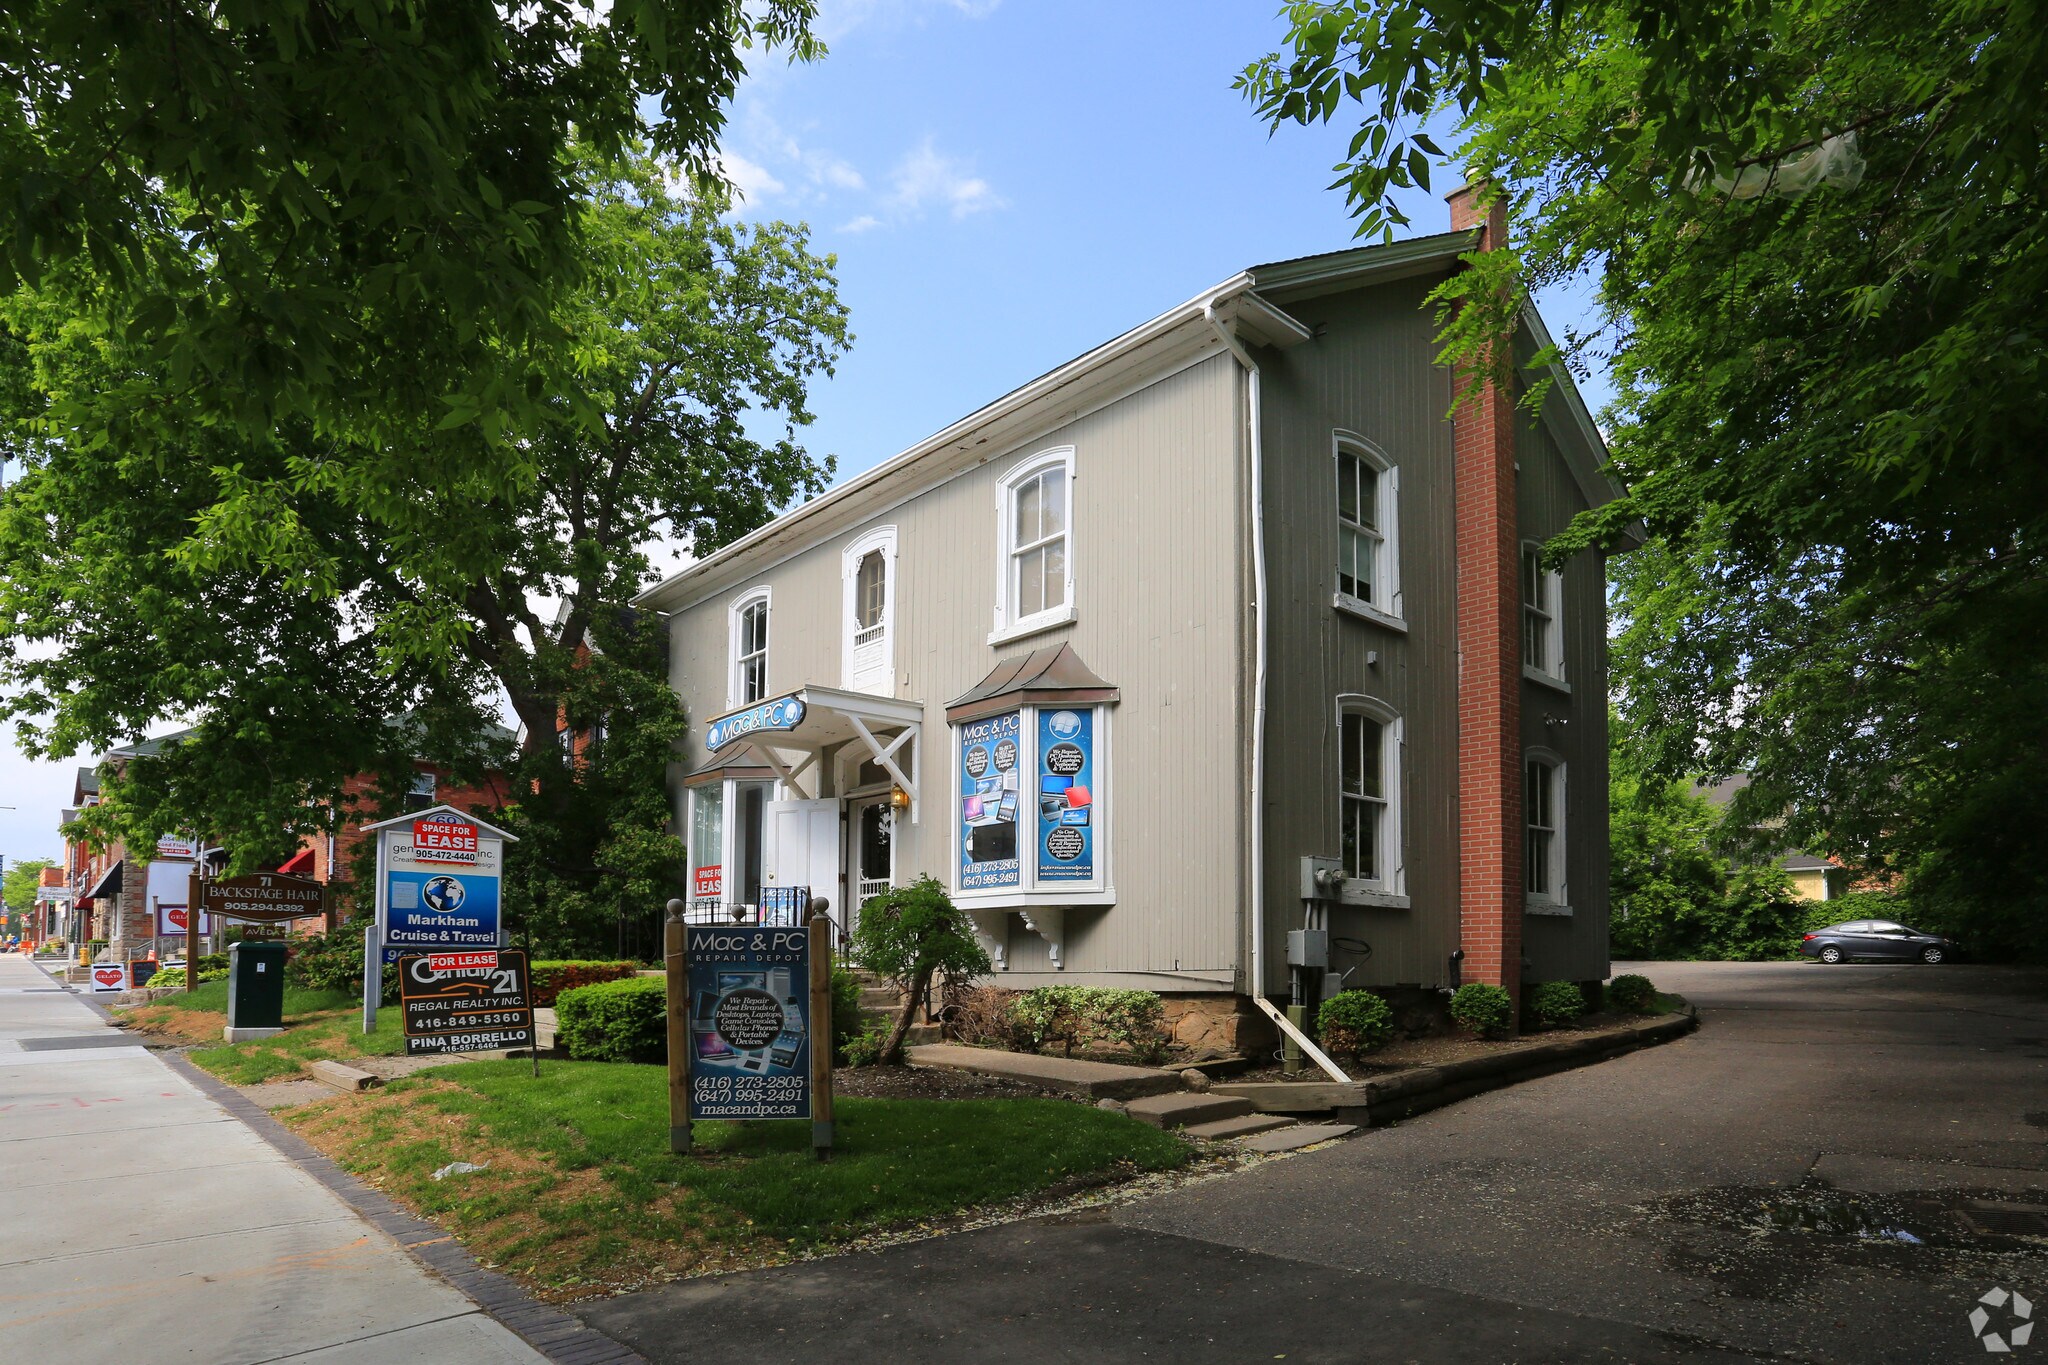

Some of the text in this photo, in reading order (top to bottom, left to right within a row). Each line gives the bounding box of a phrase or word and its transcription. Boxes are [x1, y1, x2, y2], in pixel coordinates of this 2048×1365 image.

[720, 702, 783, 742] Mac & PC
[963, 714, 1020, 740] Mac & PC
[964, 730, 1018, 746] REPAIR DEPOT
[422, 824, 470, 835] SPACE FOR
[416, 834, 475, 850] LEASE
[416, 850, 475, 862] 905-472-4440
[477, 849, 495, 859] inc.
[699, 869, 714, 879] SPACE
[963, 860, 1019, 875] (416) 273-2805
[260, 877, 272, 887] 71
[963, 872, 1018, 887] (647) 995-2491
[209, 886, 319, 900] BACKSTAGE HAIR
[696, 880, 721, 894] LEAS
[224, 902, 304, 913] 905.294.8392
[408, 914, 479, 926] Markham
[390, 929, 438, 941] Cruise
[439, 930, 450, 941] &
[692, 932, 806, 951] Mac & PC
[431, 955, 496, 966] FOR LEASE
[696, 954, 801, 962] REPAIR DEPOT
[491, 970, 518, 994] 21
[409, 996, 524, 1012] REGAL REALTY INC.
[743, 997, 769, 1005] Repair
[769, 1004, 778, 1012] of
[415, 1012, 520, 1029] 416-849-5360
[716, 1011, 782, 1019] Desktops, Laptops,
[411, 1030, 527, 1049] PINA BORRELLO
[440, 1041, 499, 1052] 416-557-6464
[694, 1076, 804, 1091] (416) 273-2805
[694, 1089, 802, 1104] (647) 995-2491
[700, 1102, 797, 1117] macandpc.ca
